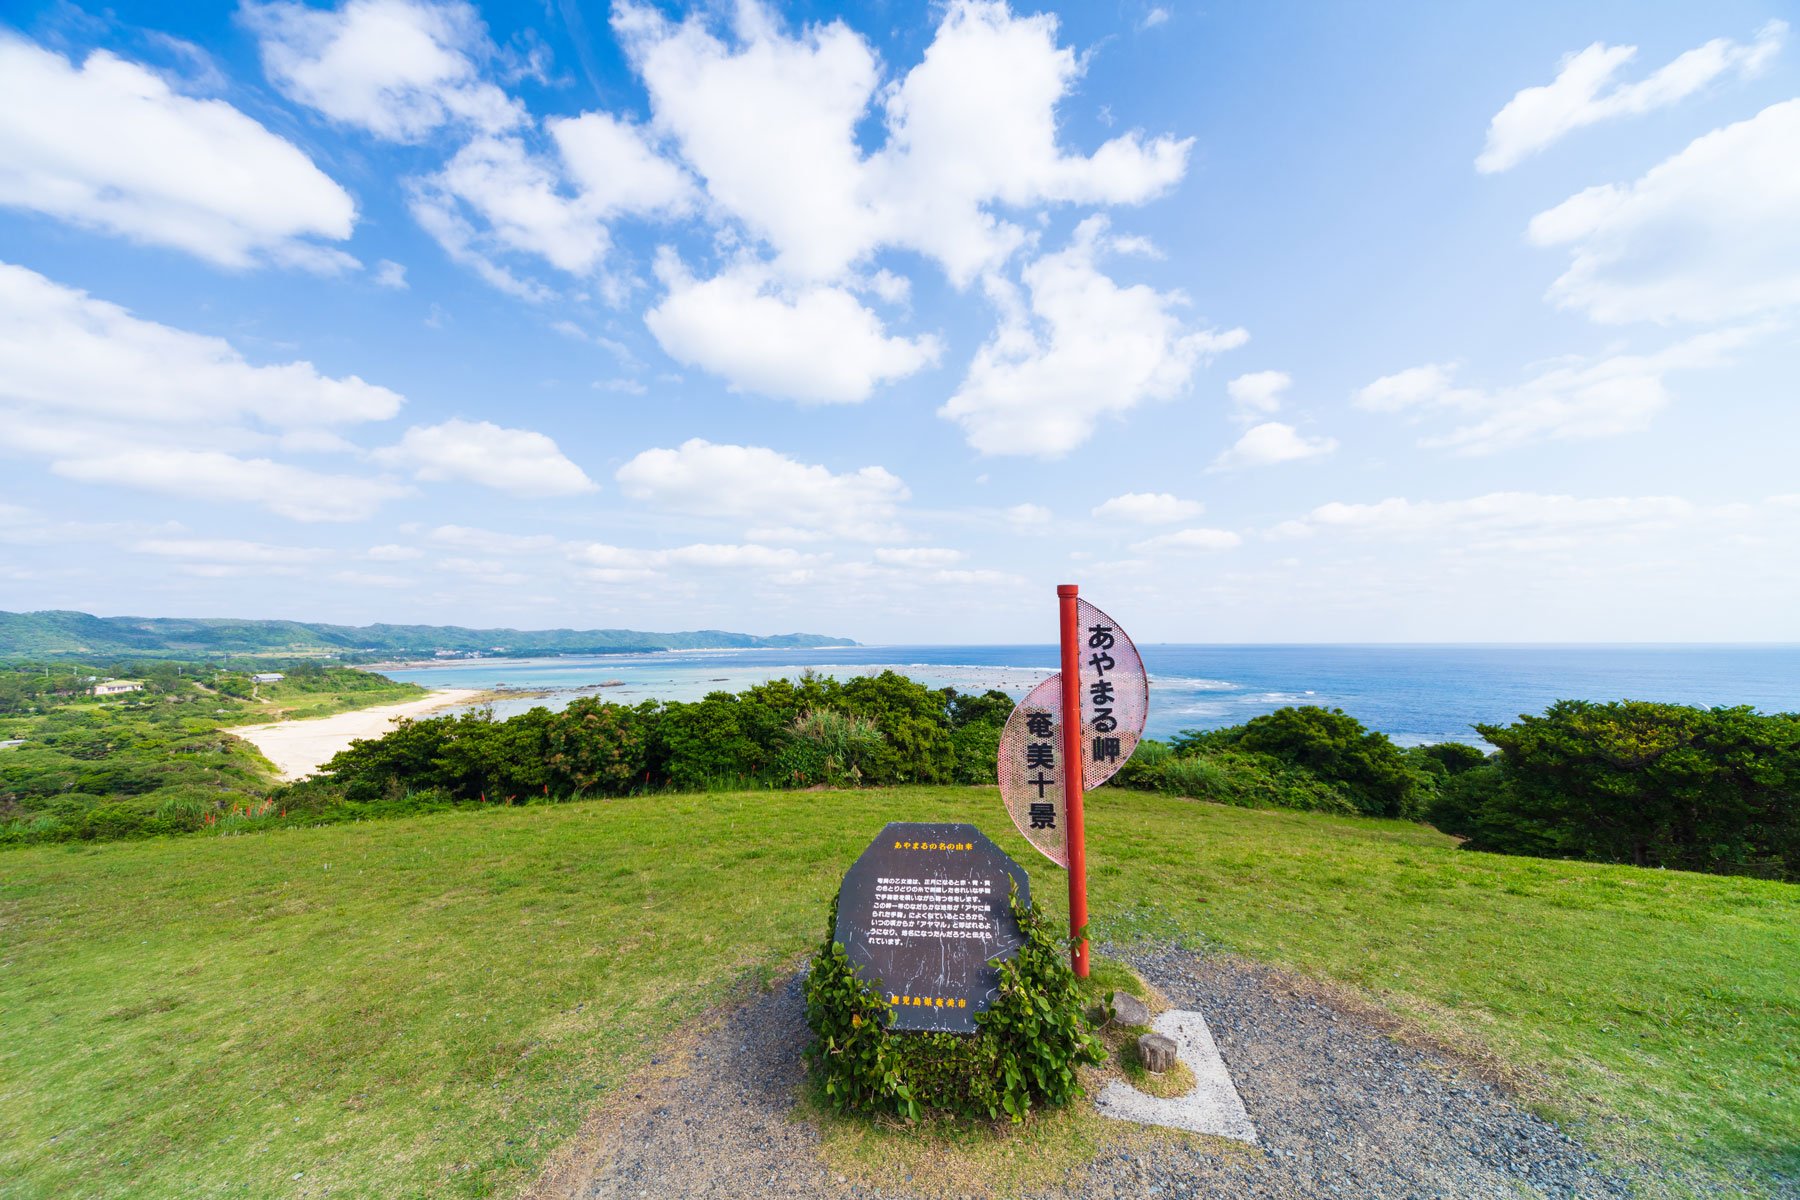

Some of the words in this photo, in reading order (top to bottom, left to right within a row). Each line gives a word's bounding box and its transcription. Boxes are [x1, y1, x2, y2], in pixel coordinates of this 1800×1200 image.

[1088, 624, 1121, 764] あやまる岬
[1026, 711, 1056, 830] 奄美十景
[894, 841, 973, 851] あやまるの名の由来
[868, 937, 903, 946] れています。
